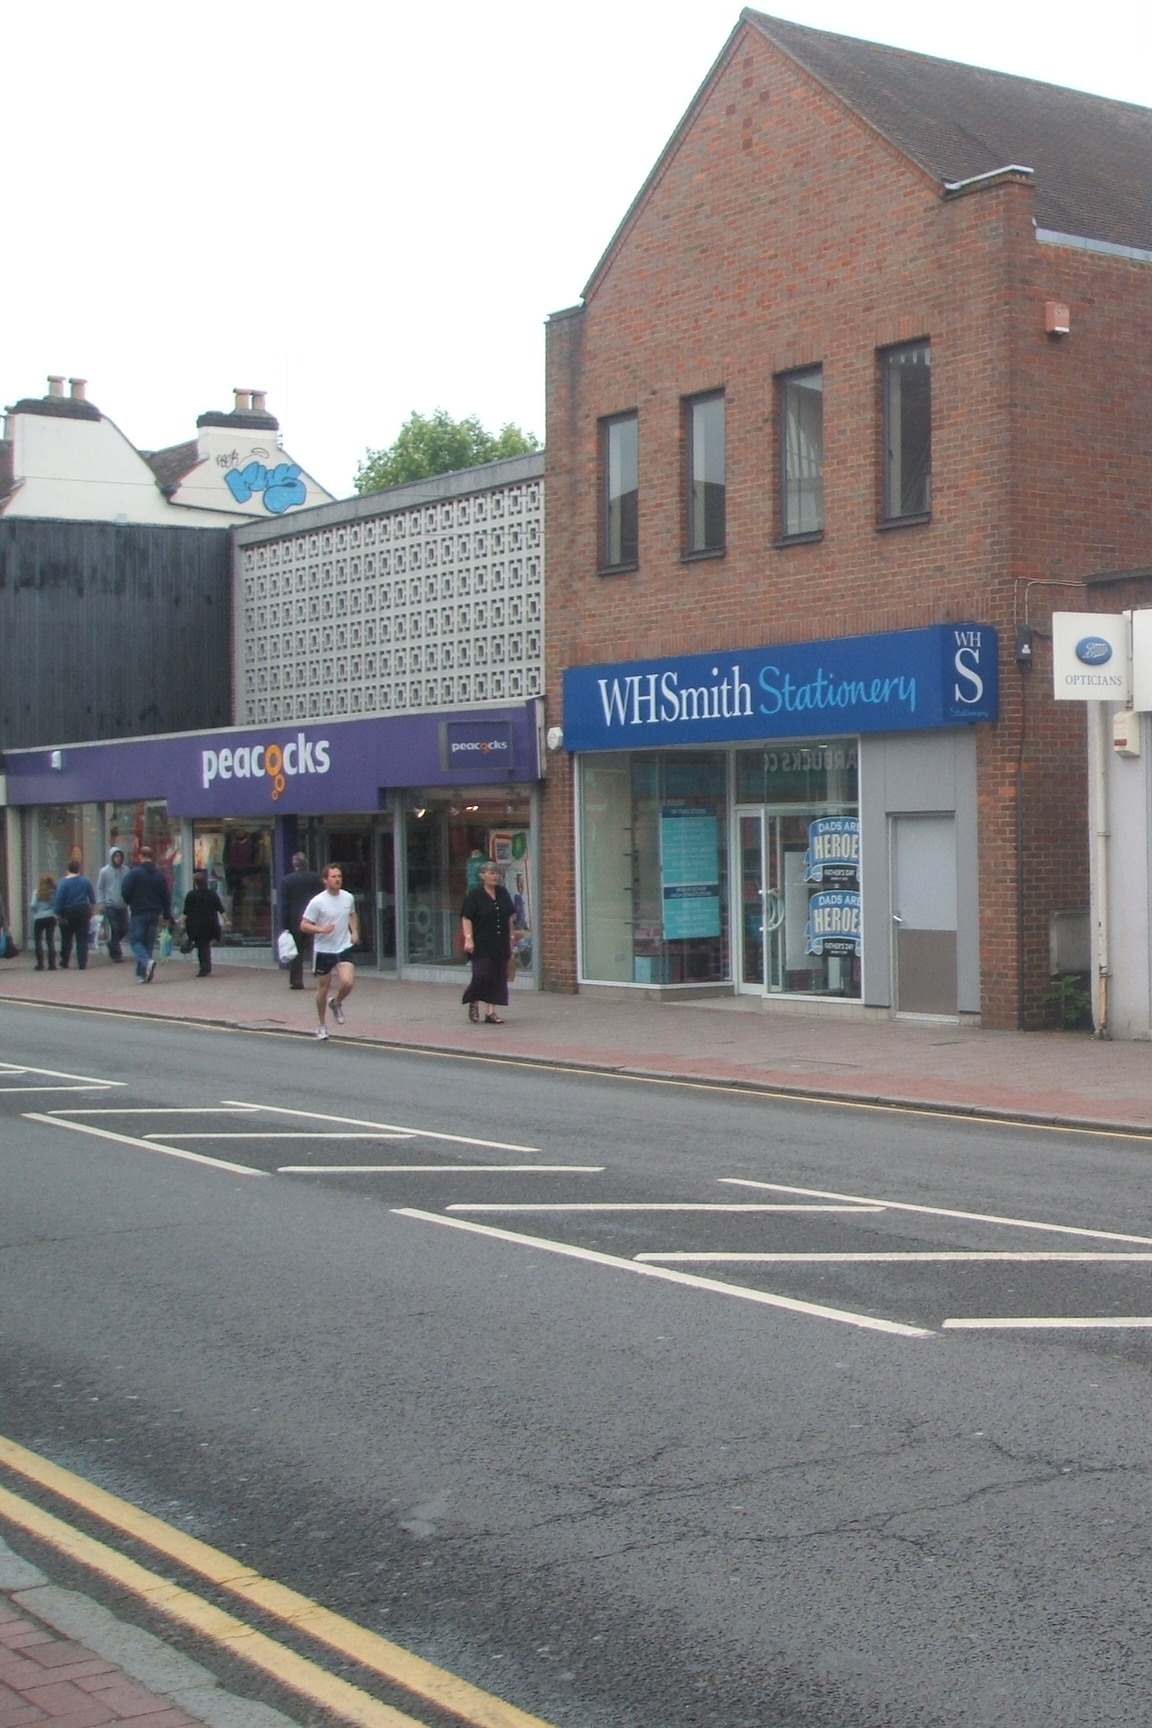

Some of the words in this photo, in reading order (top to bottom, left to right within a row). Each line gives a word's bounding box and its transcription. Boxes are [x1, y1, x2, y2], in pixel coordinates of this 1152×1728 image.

[954, 630, 981, 647] WH
[954, 647, 984, 704] S
[1065, 673, 1123, 687] OPTICIANS
[598, 665, 754, 727] WHSmith
[758, 665, 917, 714] Stationery
[452, 740, 508, 753] peacocks
[202, 733, 330, 796] peacocks
[818, 821, 843, 833] DADS
[818, 895, 843, 906] DADS
[814, 907, 862, 934] HEROE
